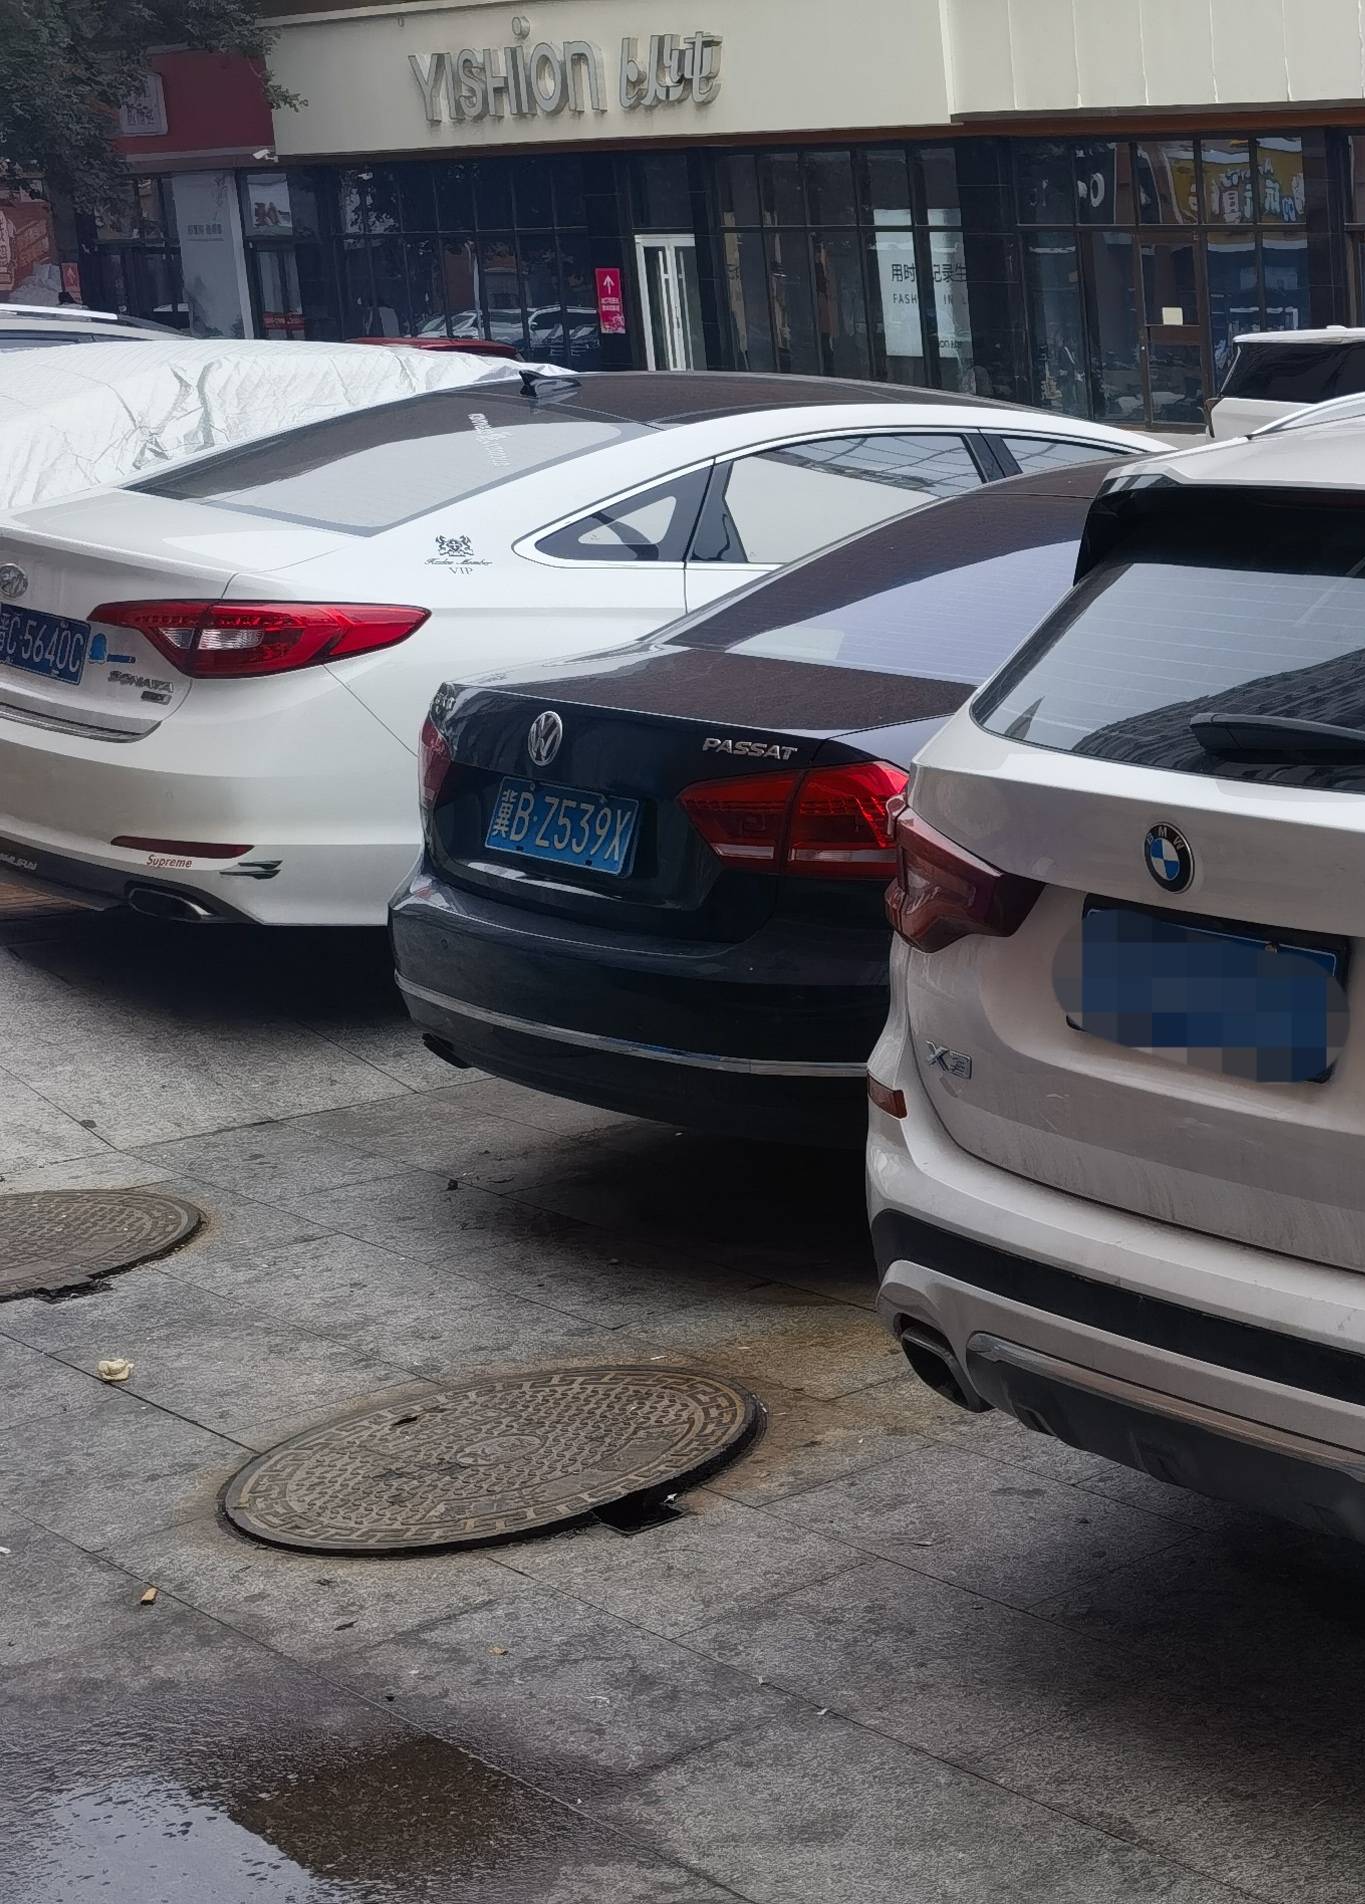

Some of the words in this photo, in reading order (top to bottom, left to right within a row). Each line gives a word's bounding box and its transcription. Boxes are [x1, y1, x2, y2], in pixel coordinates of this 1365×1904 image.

[448, 566, 474, 576] VIP
[702, 737, 799, 761] PASSAT
[490, 788, 632, 861] 冀B·Z539X
[1146, 826, 1186, 851] BMW
[146, 853, 193, 869] Supreme
